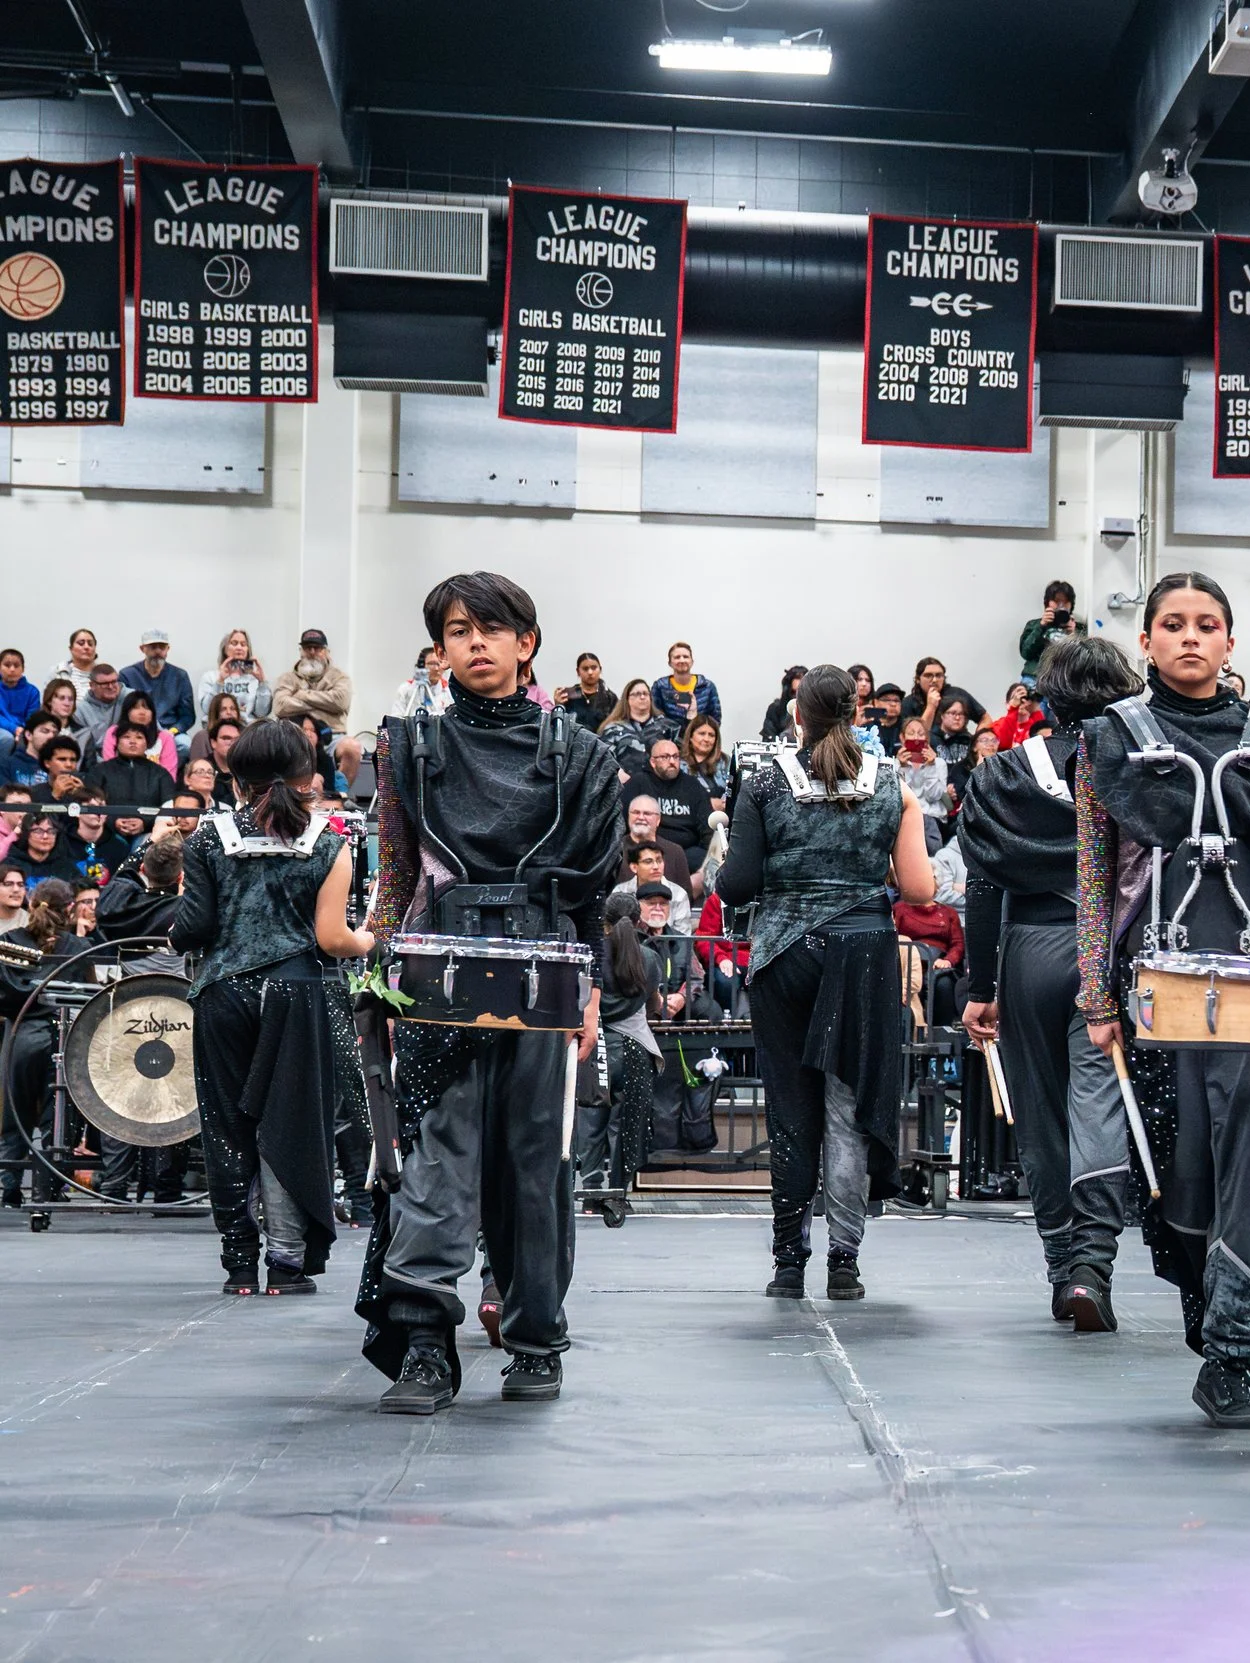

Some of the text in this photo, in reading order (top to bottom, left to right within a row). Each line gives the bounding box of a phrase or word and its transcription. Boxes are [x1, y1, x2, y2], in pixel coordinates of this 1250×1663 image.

[0, 168, 99, 212] AGUE
[164, 177, 285, 214] LEAGUE
[0, 215, 114, 242] MPIONS
[154, 218, 300, 250] CHAMPIONS
[548, 204, 648, 242] LEAGUE
[908, 225, 999, 255] LEAGUE
[536, 236, 656, 271] CHAMPIONS
[886, 251, 1019, 283] CHAMPIONS
[140, 299, 312, 323] GIRLS BASKETBALL
[518, 308, 667, 337] GIRLS BASKETBALL
[7, 332, 121, 349] BASKETBALL
[146, 324, 307, 347] 1998 1999 2000
[930, 328, 971, 348] BOYS
[9, 355, 109, 373] 1979 1980
[146, 348, 307, 371] 2001 2002 2003
[519, 339, 661, 364] 2007 2008 2009 2010
[883, 344, 1015, 369] CROSS COUNTRY
[518, 357, 660, 381] 2011 2012 2013 2014
[878, 364, 1019, 389] 2004 2008 2009
[8, 378, 111, 397] 1993 1994
[145, 373, 307, 396] 2004 2005 2006
[517, 374, 660, 399] 2015 2016 2017 2018
[878, 383, 967, 405] 2010 2021
[9, 401, 57, 419] 1996
[65, 401, 109, 418] 1997
[516, 391, 622, 414] 2019 2020 2021
[123, 1012, 191, 1040] Zildjian
